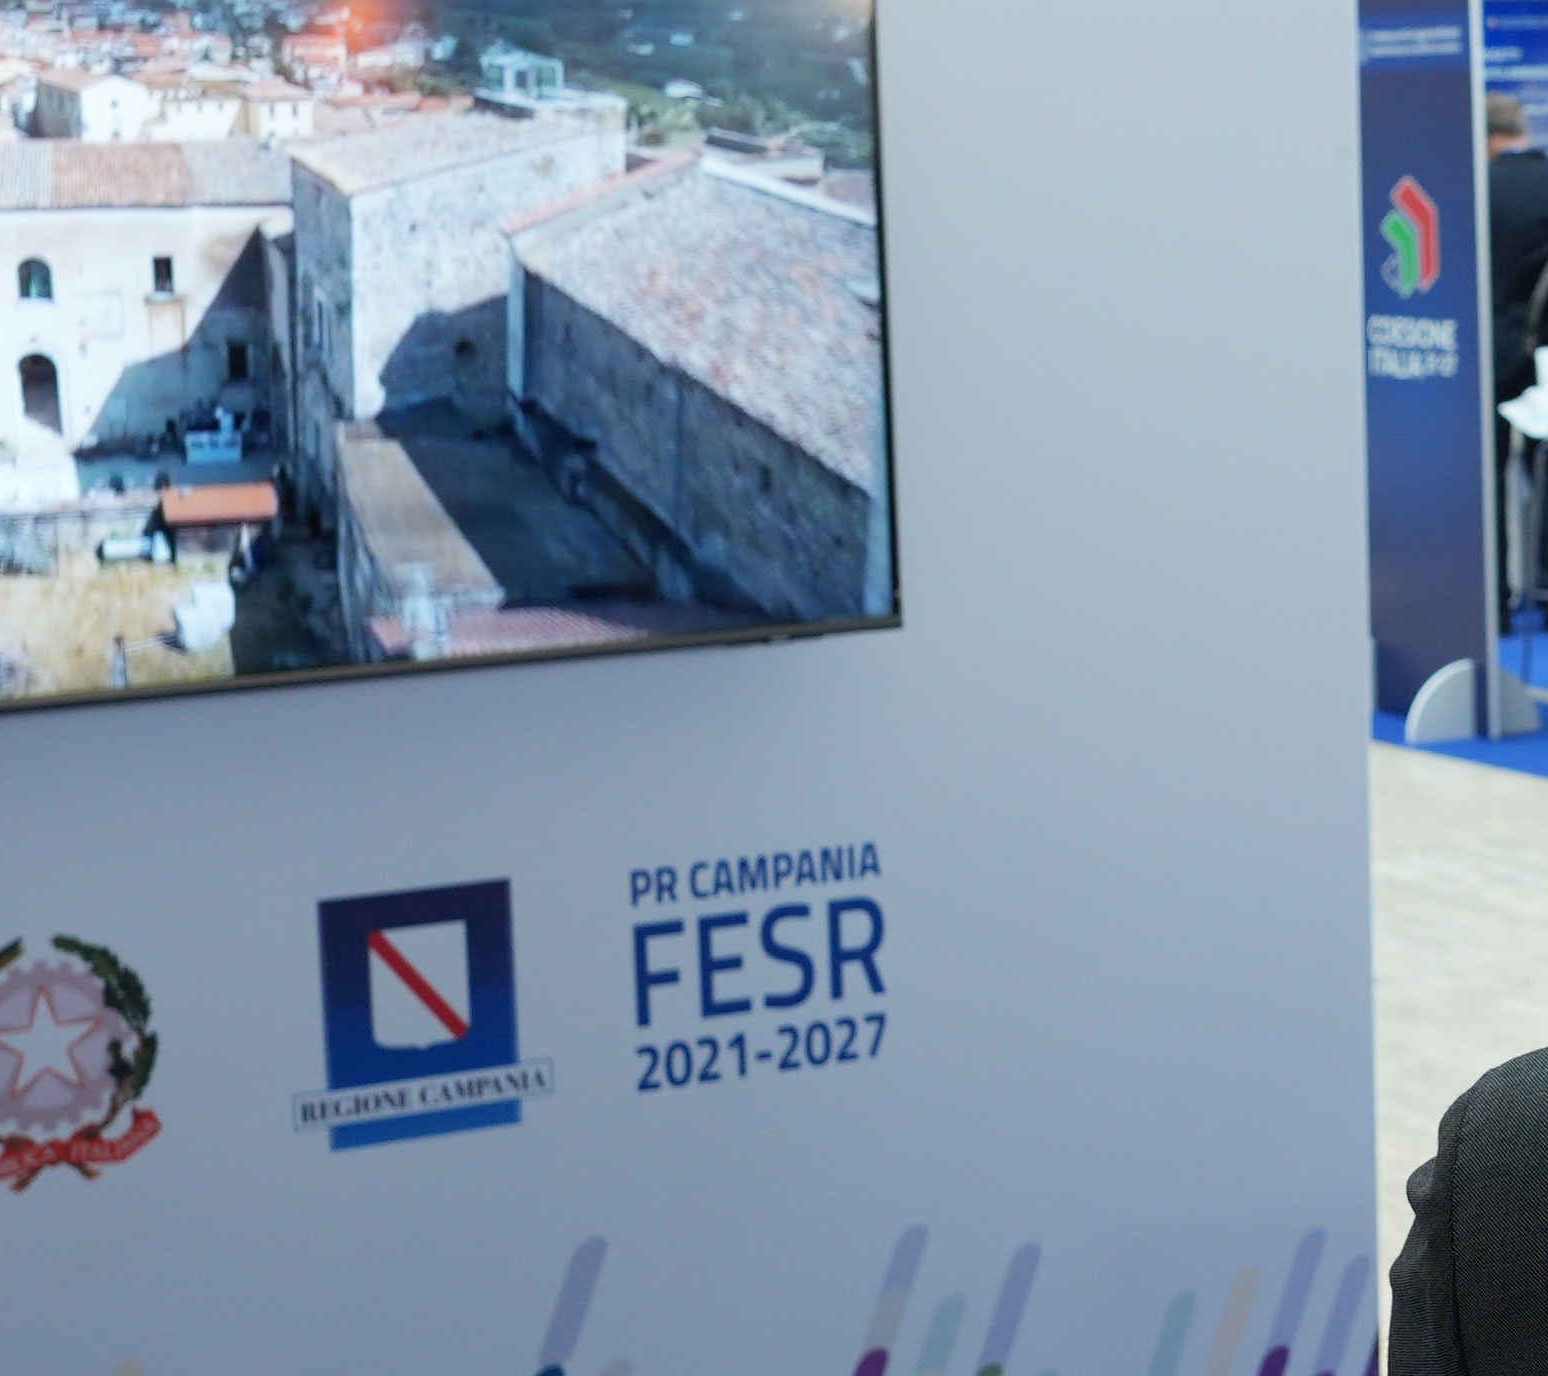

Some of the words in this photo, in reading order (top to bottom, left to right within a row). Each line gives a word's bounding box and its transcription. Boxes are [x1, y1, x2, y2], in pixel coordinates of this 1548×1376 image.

[630, 866, 678, 908] PR
[689, 841, 881, 900] CAMPANIA
[633, 896, 886, 1028] FESR
[635, 1013, 887, 1092] 2021-2027
[301, 1088, 407, 1124] REGIONE
[418, 1069, 548, 1106] CAMPANIA
